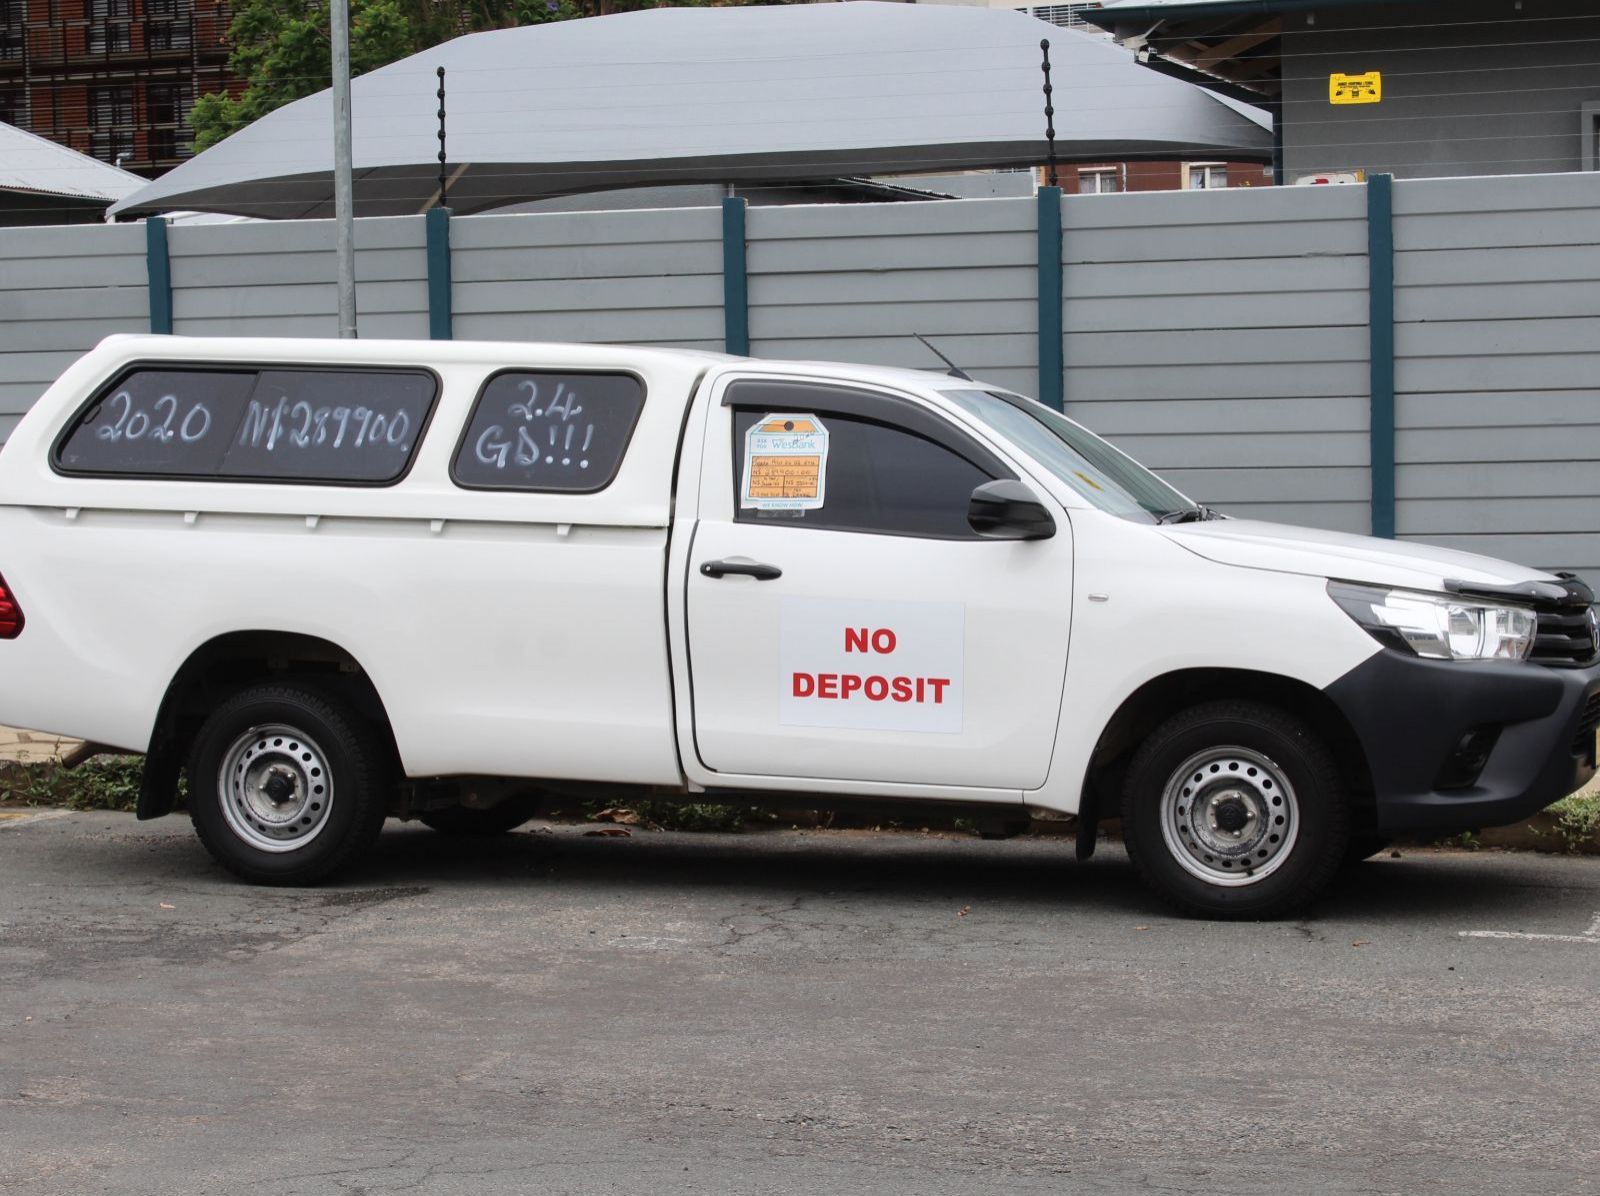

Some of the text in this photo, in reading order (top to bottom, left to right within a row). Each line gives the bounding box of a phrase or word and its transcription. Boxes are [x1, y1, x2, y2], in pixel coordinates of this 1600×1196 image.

[97, 391, 212, 442] 2020
[845, 627, 897, 655] NO
[792, 672, 951, 704] DEPOSIT
